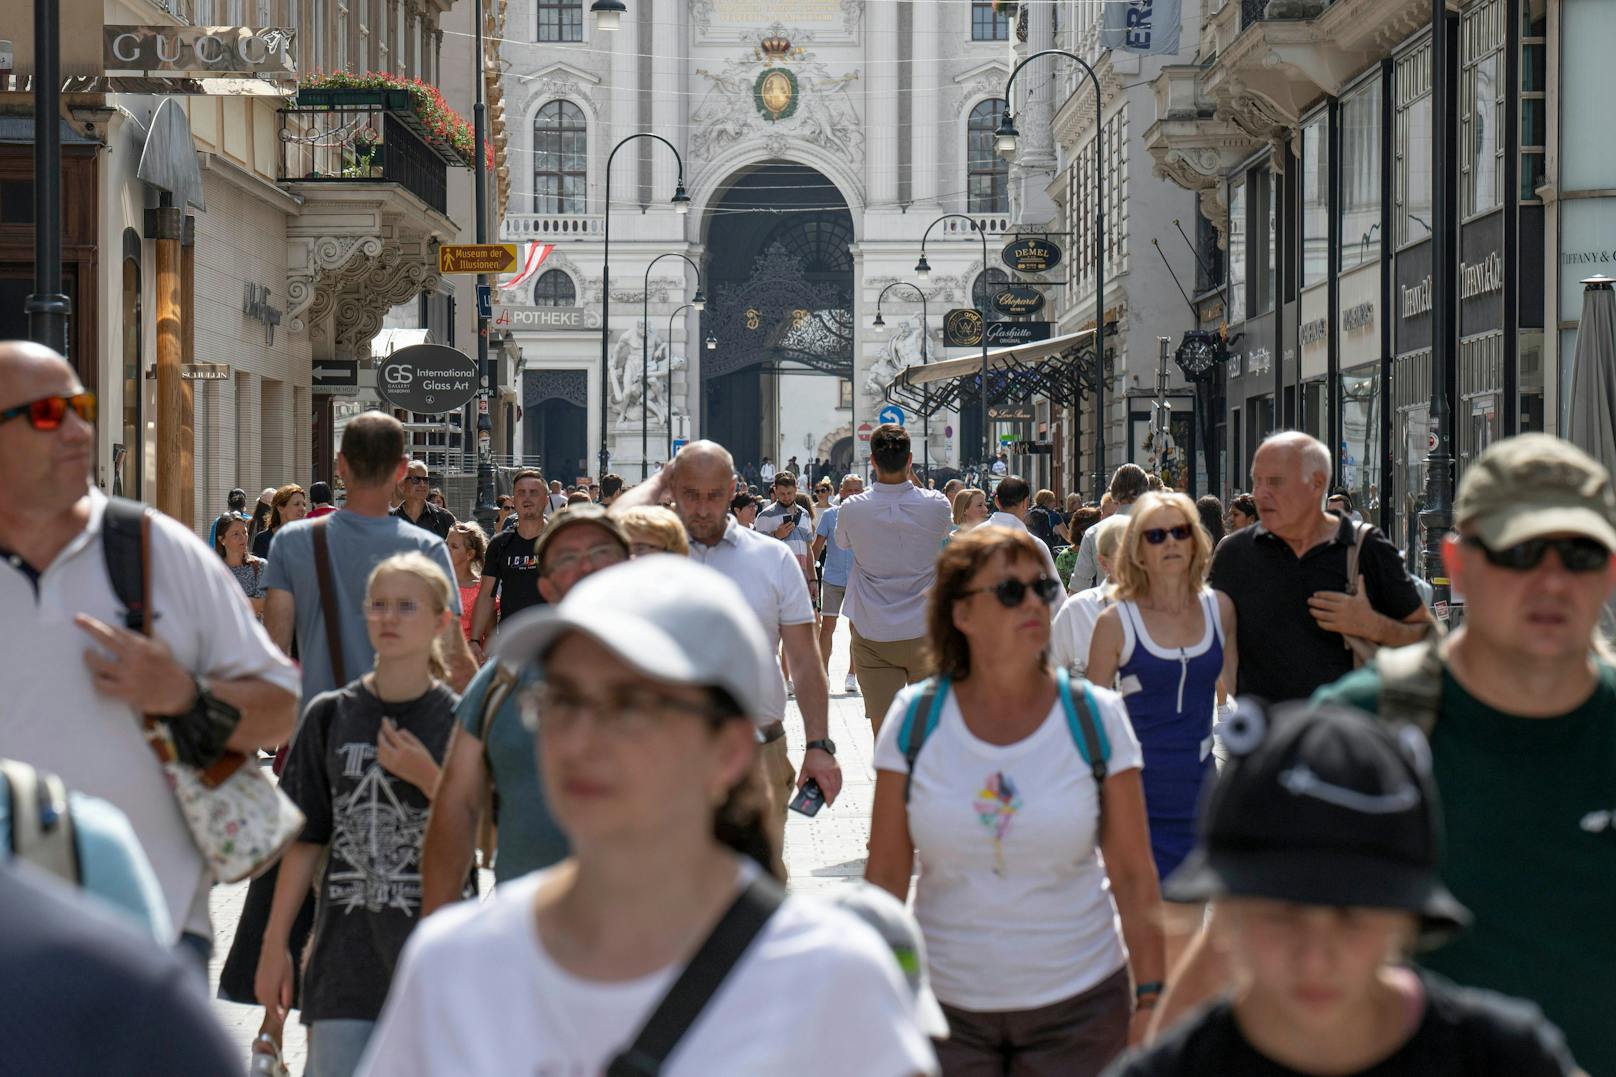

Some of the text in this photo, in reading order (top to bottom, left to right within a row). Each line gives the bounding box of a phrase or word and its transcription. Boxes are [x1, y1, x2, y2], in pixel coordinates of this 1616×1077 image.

[112, 33, 288, 65] GUCCI
[455, 248, 503, 258] Museum der
[1015, 248, 1049, 258] DEMEL
[1561, 251, 1599, 264] TIFFANY
[460, 260, 499, 269] Illusionen
[996, 293, 1039, 308] Chopard
[385, 364, 413, 384] GS
[417, 368, 475, 377] International
[423, 380, 469, 391] Glass Art
